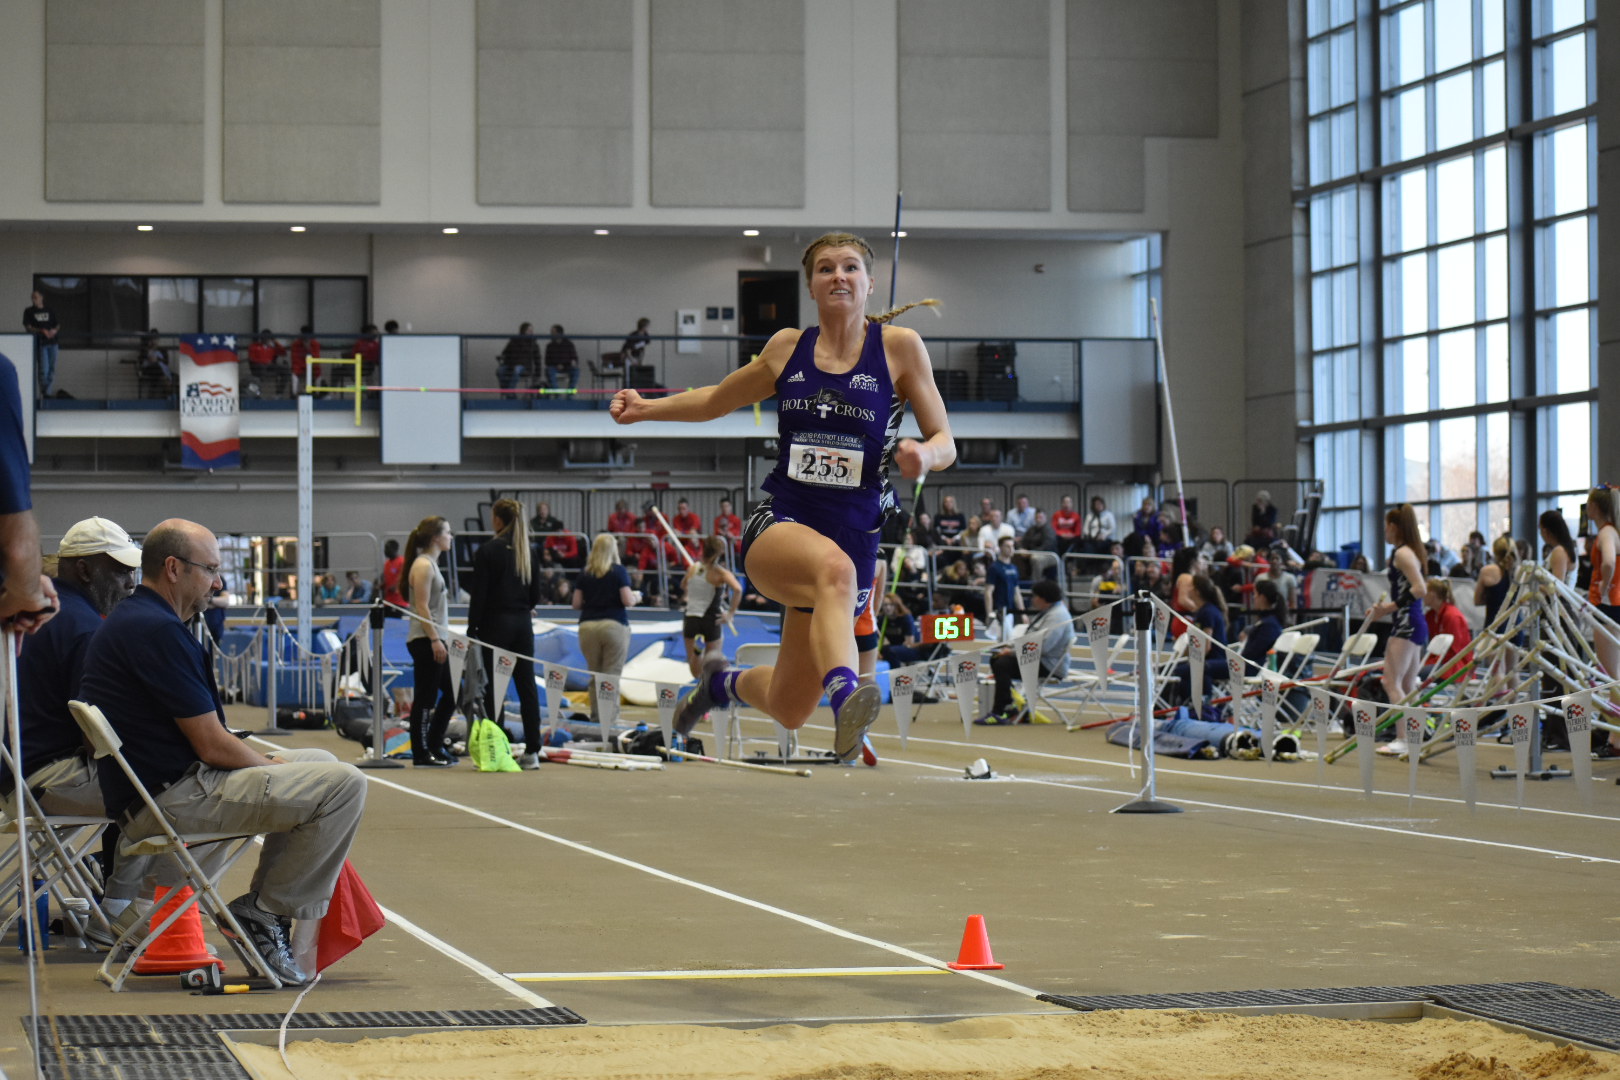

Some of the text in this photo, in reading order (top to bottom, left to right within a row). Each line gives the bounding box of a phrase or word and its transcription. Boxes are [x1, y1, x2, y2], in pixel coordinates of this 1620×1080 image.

[782, 398, 876, 421] HOLY CROSS
[813, 433, 837, 441] PATRIOT
[801, 453, 850, 478] 255
